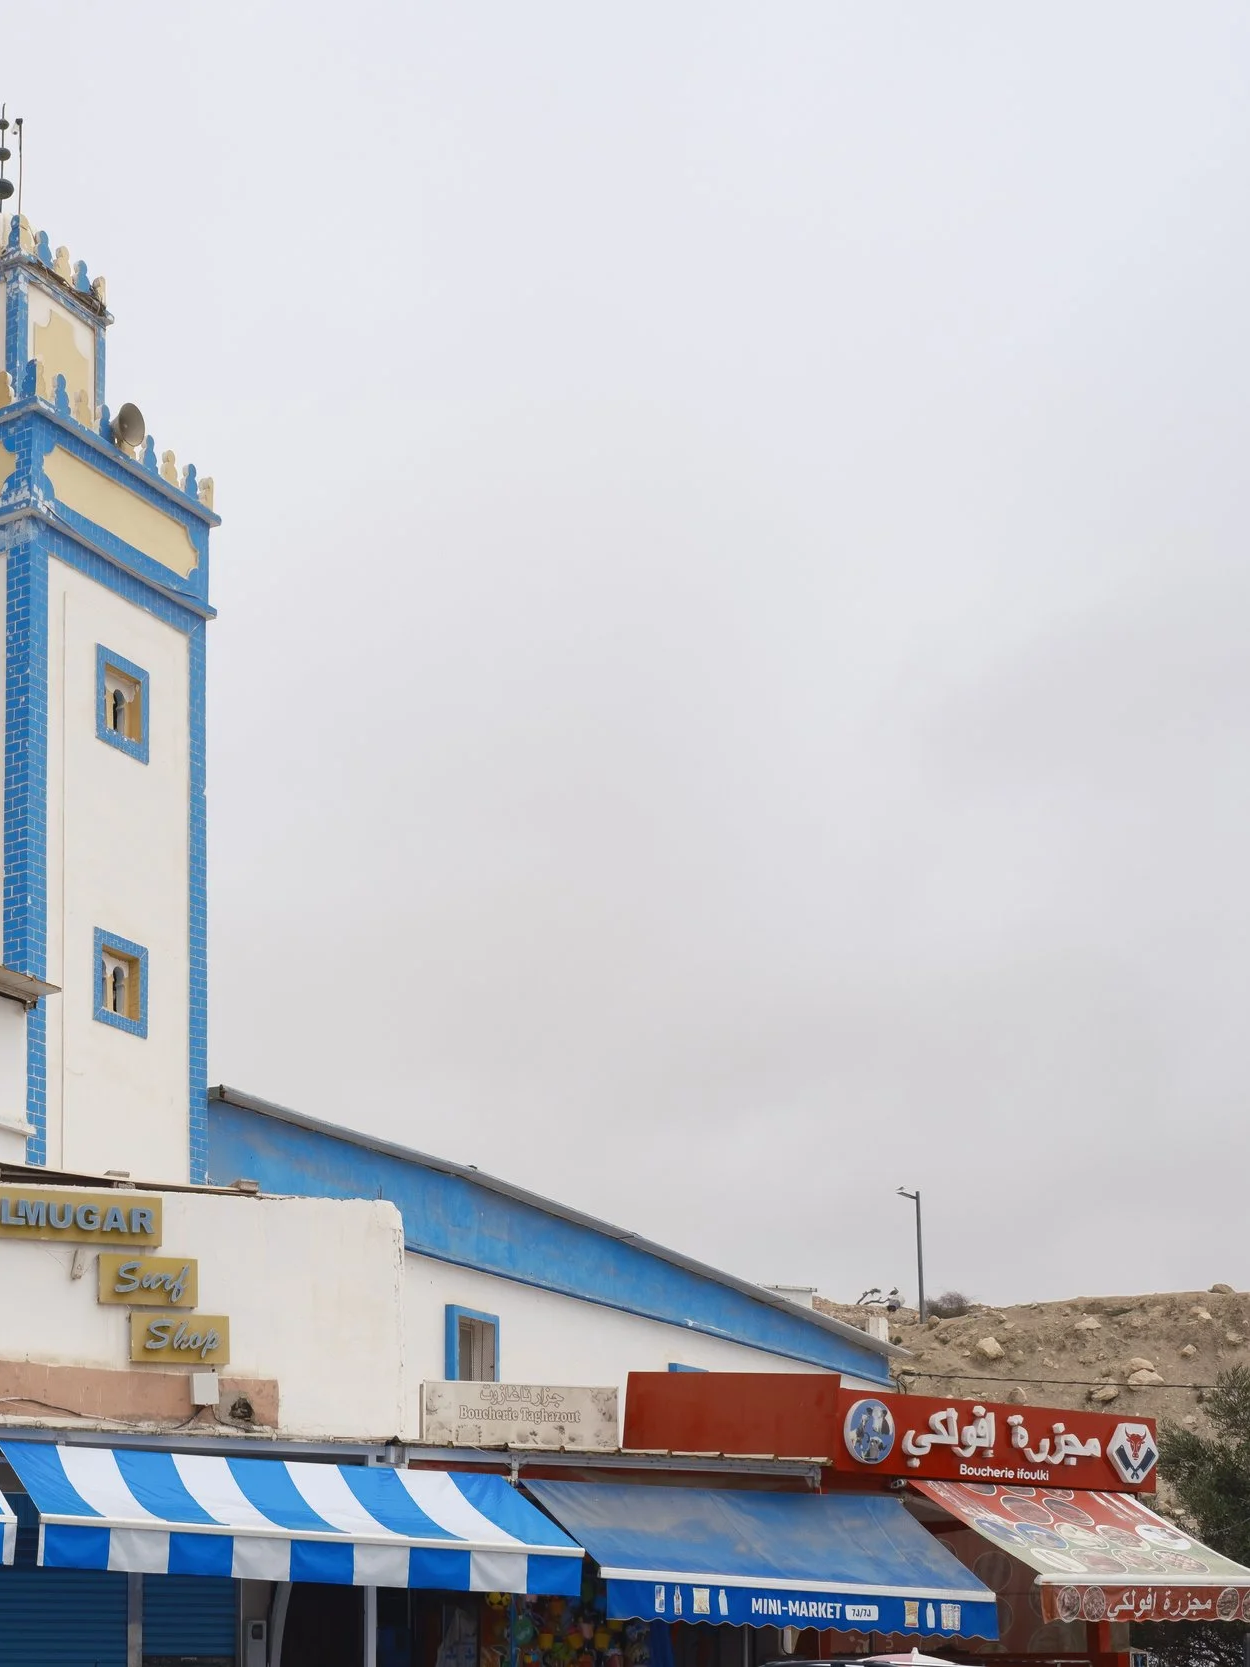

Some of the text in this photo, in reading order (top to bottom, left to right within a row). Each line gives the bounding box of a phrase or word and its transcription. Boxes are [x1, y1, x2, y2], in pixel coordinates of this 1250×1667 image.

[114, 1260, 190, 1304] Surf
[145, 1319, 220, 1359] Shop
[531, 1386, 565, 1408] جزار
[459, 1404, 581, 1424] Boucherie Taghazout
[1007, 1414, 1101, 1466] مجزرة
[959, 1464, 1049, 1481] Boucherie ifoulki
[751, 1597, 842, 1619] MINI-MARKET
[1163, 1590, 1212, 1616] مجزرة
